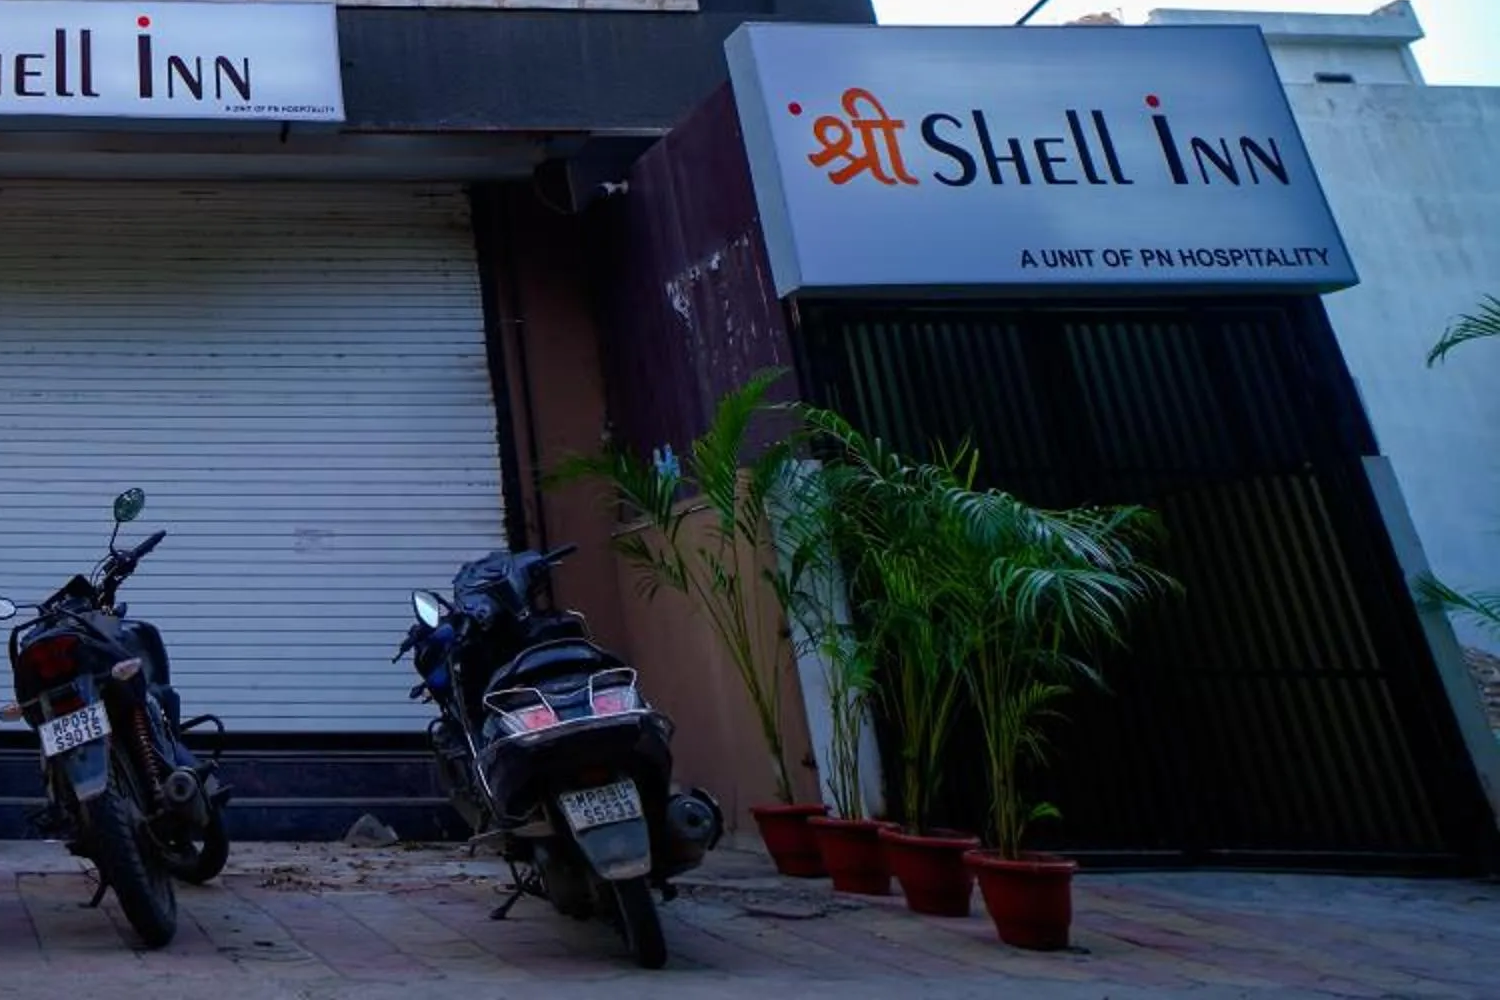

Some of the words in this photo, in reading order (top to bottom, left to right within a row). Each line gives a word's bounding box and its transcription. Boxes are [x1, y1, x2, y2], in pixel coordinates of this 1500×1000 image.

[807, 87, 920, 186] श्री
[1020, 250, 1038, 269] A
[1041, 250, 1095, 268] UNIT
[1102, 250, 1134, 268] OF
[1141, 249, 1174, 267] PN
[1179, 248, 1330, 267] HOSPITALITY
